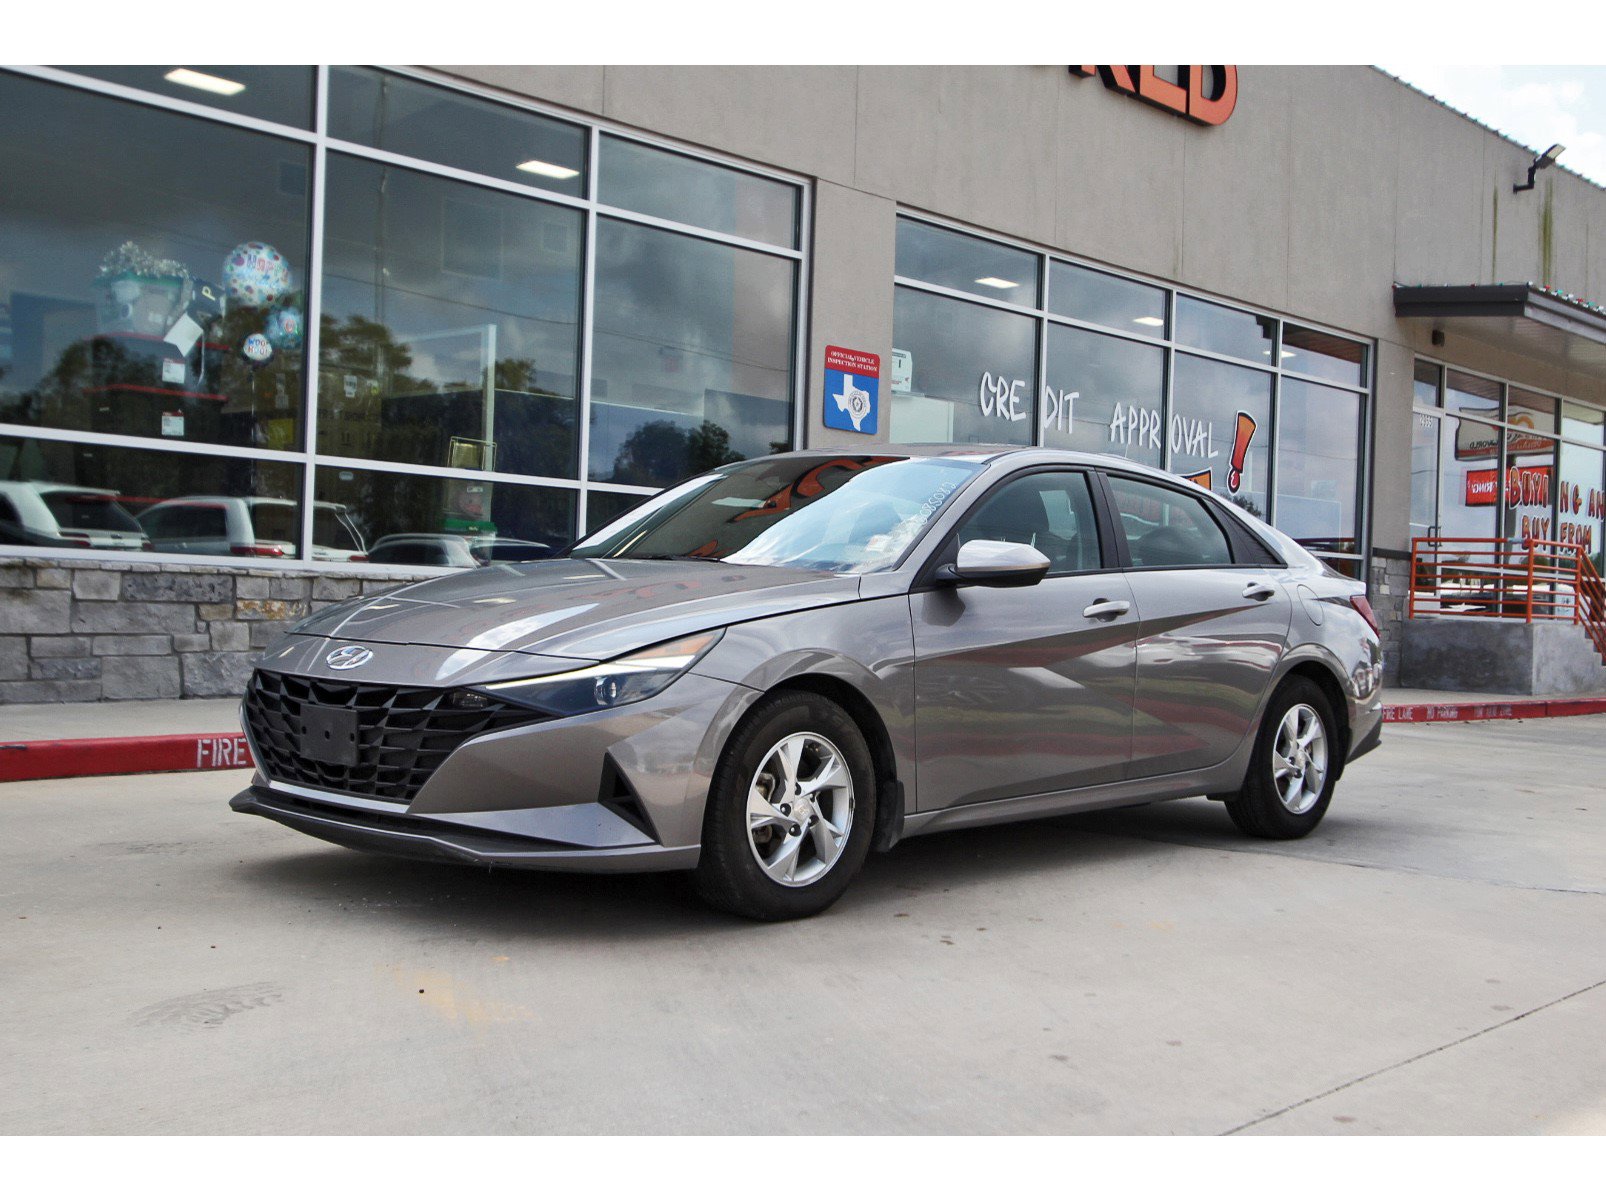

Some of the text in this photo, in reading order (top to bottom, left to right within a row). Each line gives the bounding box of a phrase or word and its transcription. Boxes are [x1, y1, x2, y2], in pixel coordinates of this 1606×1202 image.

[827, 357, 878, 371] INSPECTION STATION
[1521, 514, 1592, 555] BUY FROM
[196, 737, 247, 768] FIRE
